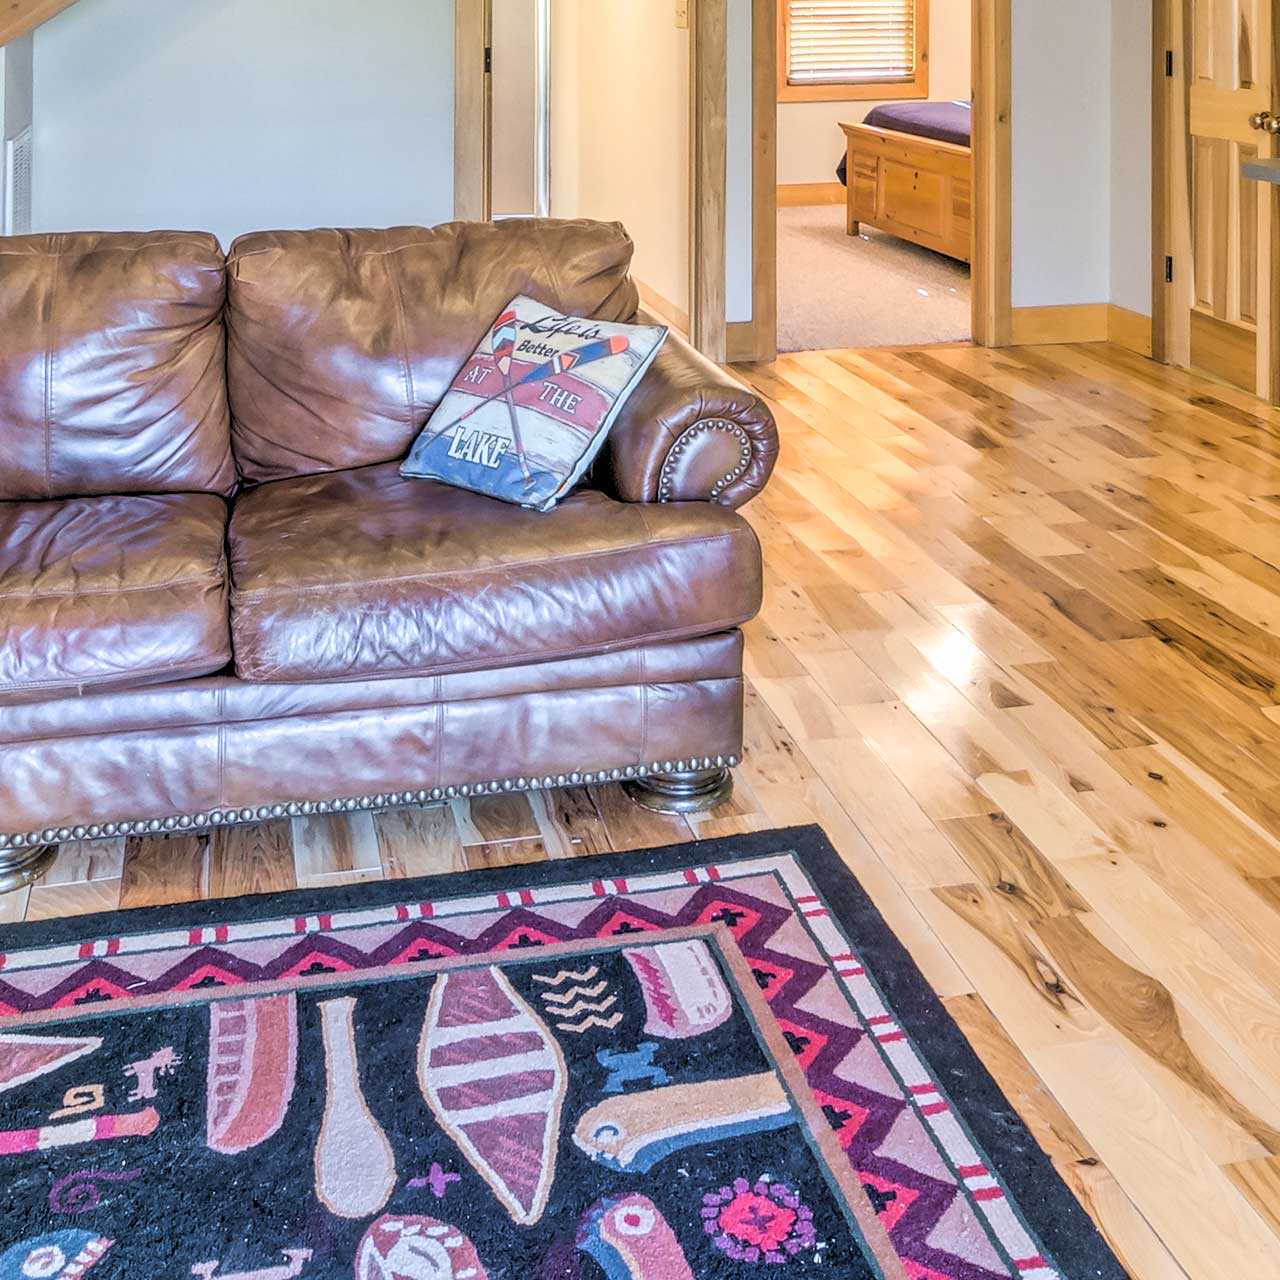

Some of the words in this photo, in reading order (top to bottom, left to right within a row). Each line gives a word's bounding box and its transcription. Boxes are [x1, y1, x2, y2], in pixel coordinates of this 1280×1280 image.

[520, 315, 580, 338] Life
[578, 324, 601, 340] is
[516, 339, 560, 358] Better
[463, 365, 495, 385] AT
[539, 381, 582, 415] THE
[447, 426, 511, 469] LAKE
